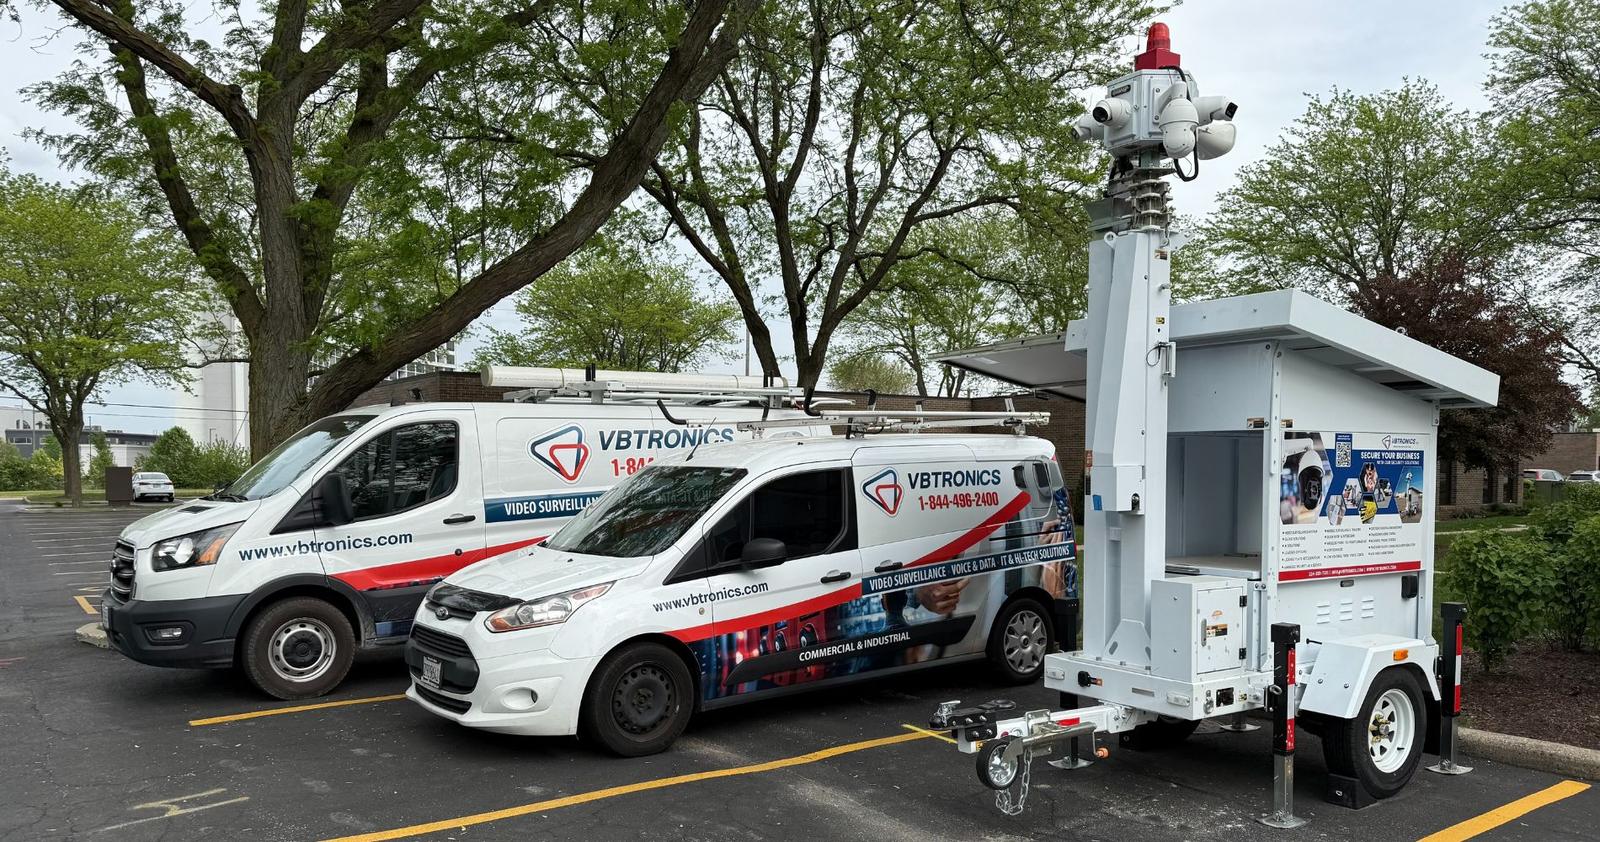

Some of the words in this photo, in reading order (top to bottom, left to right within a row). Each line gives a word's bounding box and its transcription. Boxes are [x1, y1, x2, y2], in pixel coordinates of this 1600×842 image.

[598, 428, 734, 451] VBTRONICS
[1361, 451, 1381, 459] SECURE
[908, 469, 1001, 489] VBTRONICS
[504, 501, 536, 516] VIDEO
[918, 491, 999, 511] 1-844-496-2400
[239, 531, 413, 562] www.vbtronics.com
[869, 575, 893, 591] VIDEO
[893, 566, 946, 587] SURVEILLANCE
[951, 562, 971, 576] VOICE
[972, 561, 978, 572] &
[979, 558, 996, 571] DATA
[1000, 555, 1007, 566] IT
[1008, 554, 1014, 565] &
[1015, 549, 1038, 565] HI-TECH
[1038, 545, 1070, 560] SOLUTIONS
[652, 582, 769, 613] www.vbtronics.com
[799, 641, 855, 662] COMMERCIAL
[856, 640, 864, 651] &
[864, 632, 911, 649] INDUSTRIAL
